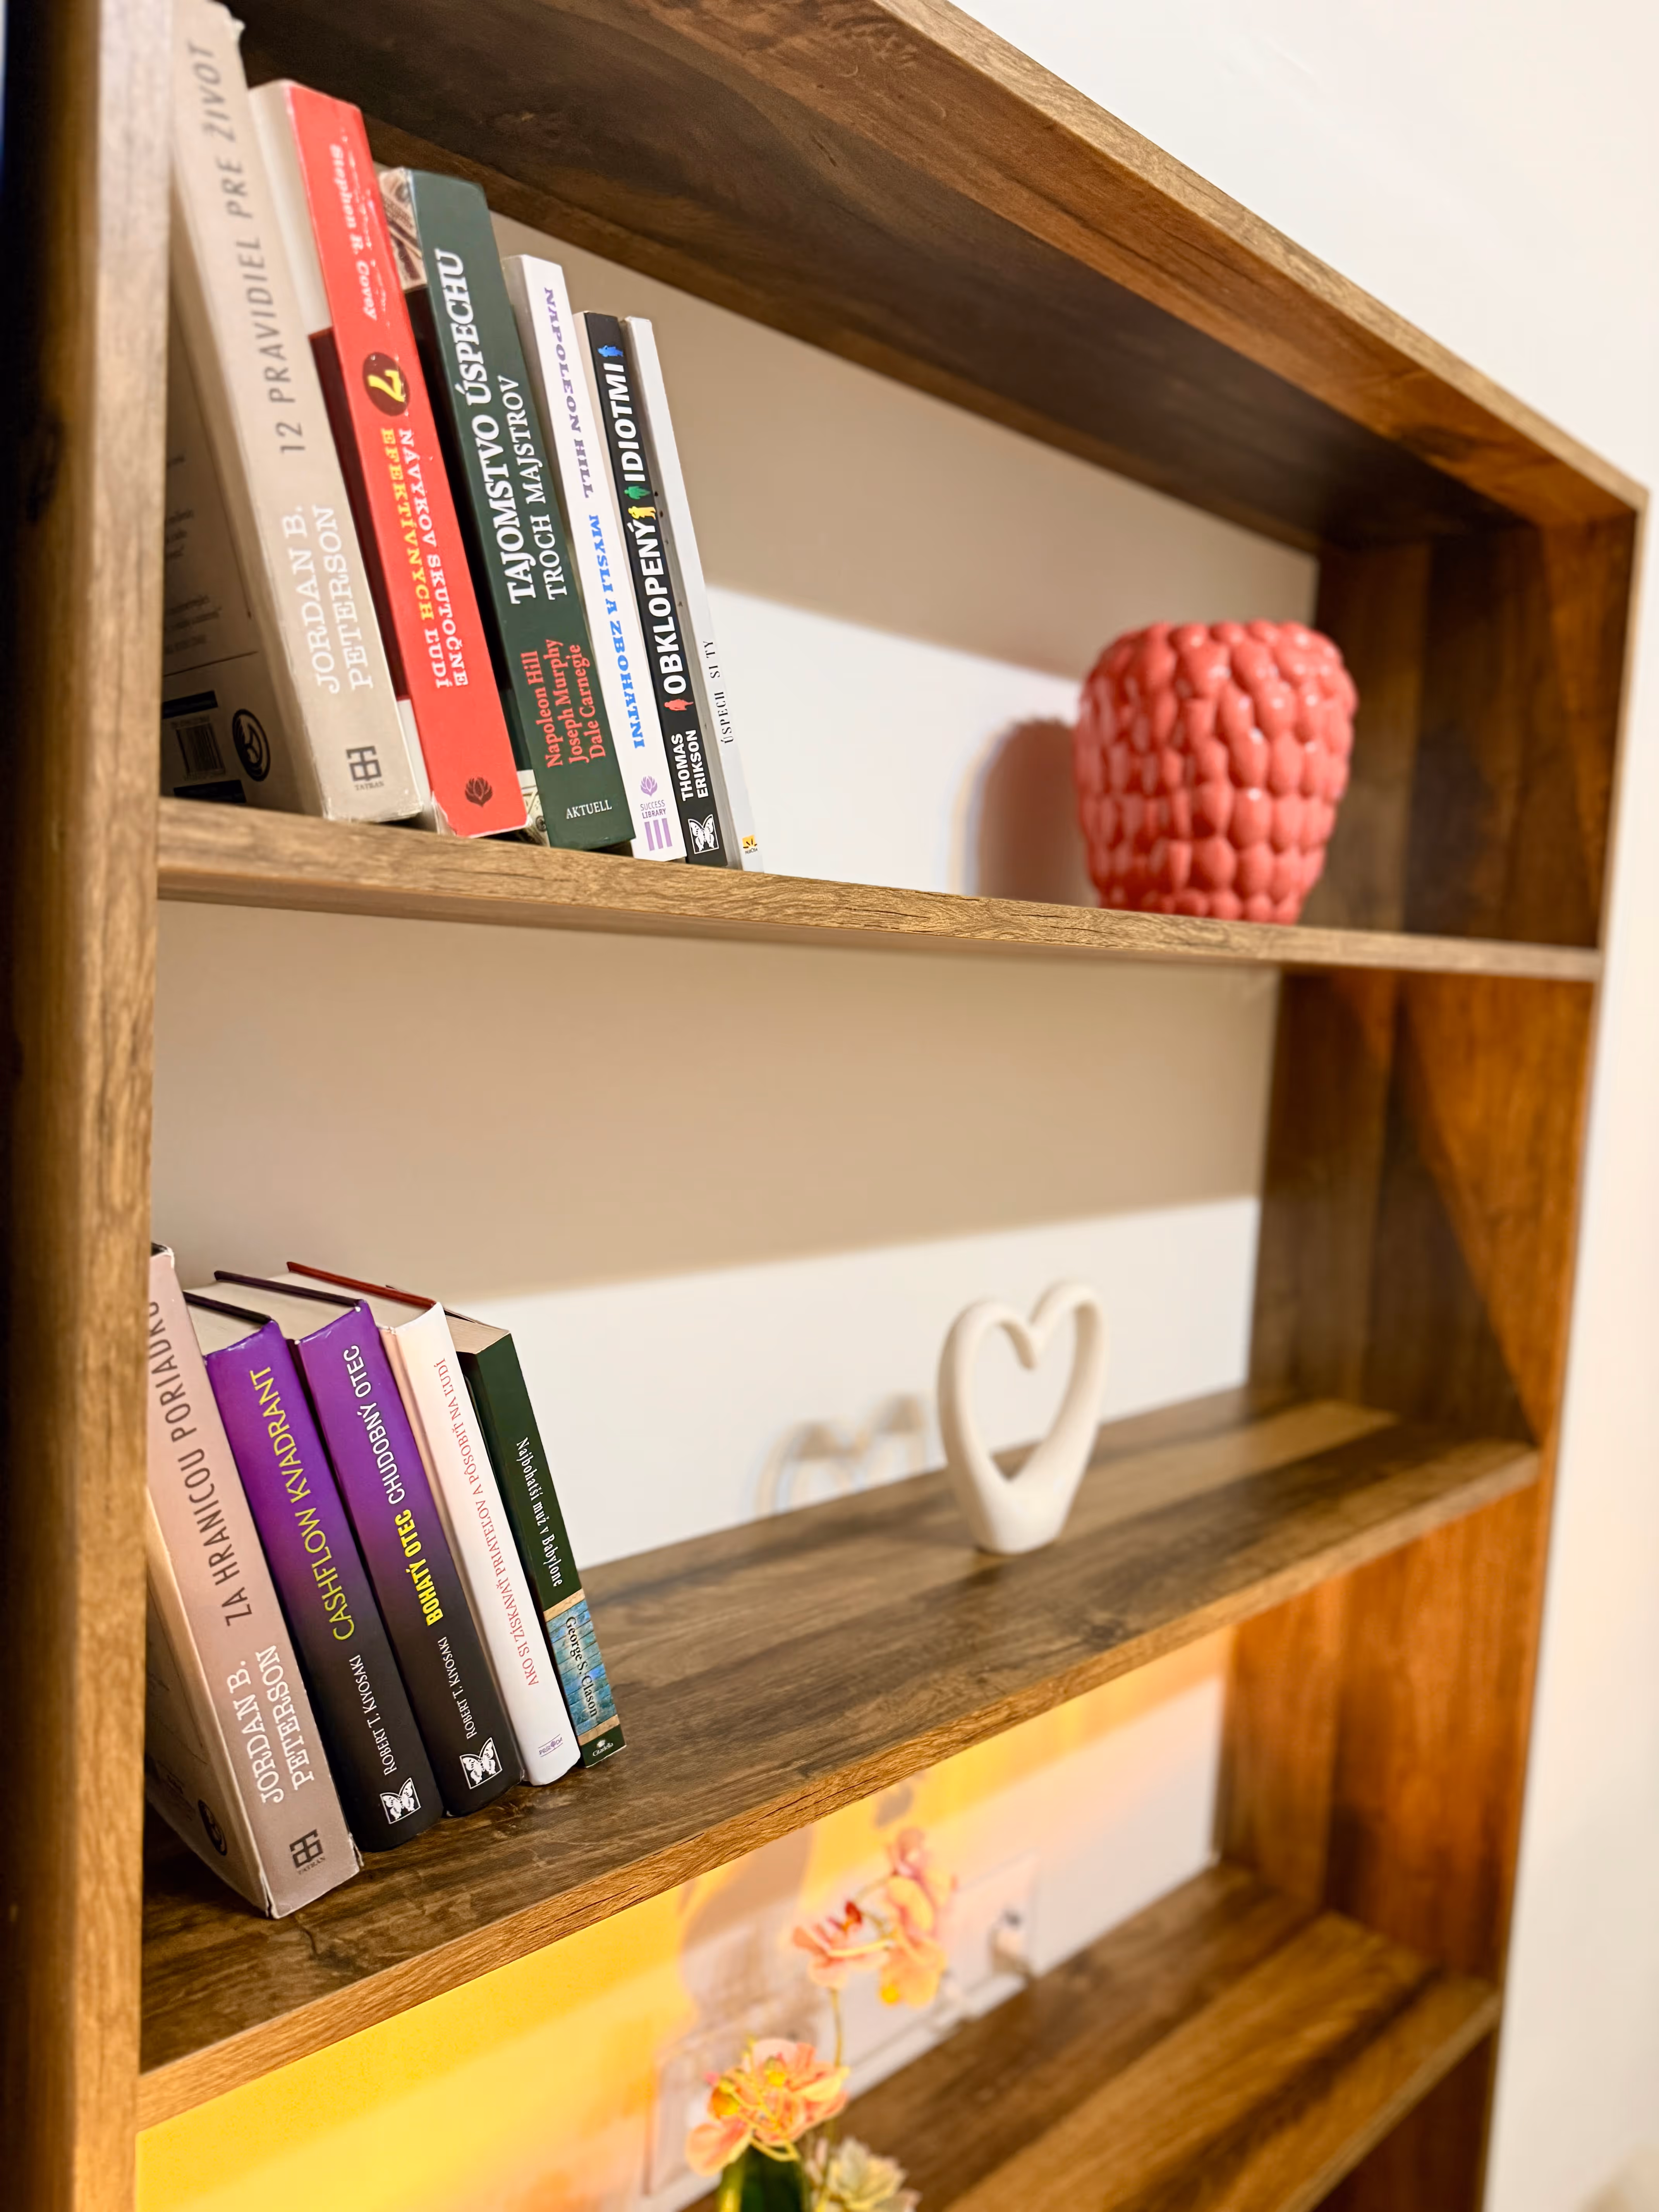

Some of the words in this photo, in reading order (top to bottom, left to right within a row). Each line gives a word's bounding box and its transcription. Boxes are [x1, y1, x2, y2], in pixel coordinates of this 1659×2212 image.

[215, 158, 253, 219] PRE
[329, 144, 356, 228] Stephen
[350, 234, 363, 254] R.
[357, 260, 376, 320] Covey
[236, 235, 295, 403] PRAVIDIEL
[434, 248, 492, 406] ÚSPECHU
[368, 370, 404, 402] 7
[544, 287, 581, 432] NAPOLEON
[574, 439, 593, 498] HILL
[275, 421, 306, 454] 12
[497, 374, 546, 504] MAJSTROV
[603, 363, 646, 481] IDIOTMI
[282, 506, 307, 539] B.
[380, 428, 434, 620] EFEKTÍVNYCH
[472, 414, 536, 605] TAJOMSTVO
[530, 514, 567, 600] TROCH
[589, 515, 613, 592] MYSLI
[288, 548, 340, 694] JORDAN
[312, 505, 374, 690] PETERSON
[427, 553, 469, 686] SKUTOČNE
[605, 598, 618, 615] A
[627, 519, 686, 695] OBKLOPENÝ
[520, 651, 543, 685] Hill
[543, 639, 572, 706] Murphy
[703, 641, 716, 658] TY
[709, 665, 720, 678] SI
[566, 644, 596, 719] Carnegie
[610, 620, 645, 749] ZBOHATNI
[534, 686, 563, 768] Napoleon
[558, 708, 589, 763] Joseph
[584, 720, 606, 759] Dale
[714, 692, 733, 744] ÚSPECH
[671, 733, 693, 802] THOMAS
[685, 730, 709, 798] ERIKSON
[566, 799, 613, 819] AKTUELL
[640, 800, 665, 811] SUCCESS
[642, 808, 666, 819] LIBRARY
[343, 1345, 371, 1398] OTEC
[250, 1367, 311, 1503] KVADRANT
[448, 1397, 462, 1420] NA
[357, 1402, 405, 1504] CHUDOBNÝ
[452, 1422, 479, 1484] PÔSOBIŤ
[178, 1449, 240, 1585] HRANICOU
[472, 1484, 483, 1495] A
[395, 1509, 421, 1557] OTEC
[476, 1500, 506, 1577] PRIATEĽOV
[533, 1501, 550, 1526] muž
[542, 1534, 562, 1587] Babylone
[295, 1508, 354, 1640] CASHFLOW
[406, 1558, 443, 1626] BOHATÝ
[222, 1587, 252, 1626] ZA
[496, 1577, 525, 1642] ZÍSKAVAŤ
[438, 1637, 460, 1687] KIYOSAKI
[517, 1641, 529, 1657] SI
[565, 1616, 582, 1661] George
[577, 1661, 588, 1674] S.
[227, 1661, 251, 1693] B.
[349, 1655, 377, 1714] KIYOSAKI
[452, 1686, 464, 1699] T.
[522, 1658, 539, 1686] AKO
[582, 1675, 598, 1717] Clason
[255, 1645, 314, 1790] PETERSON
[367, 1713, 381, 1728] T.
[457, 1699, 477, 1739] ROBERT
[233, 1694, 284, 1803] JORDAN
[373, 1728, 397, 1775] ROBERT
